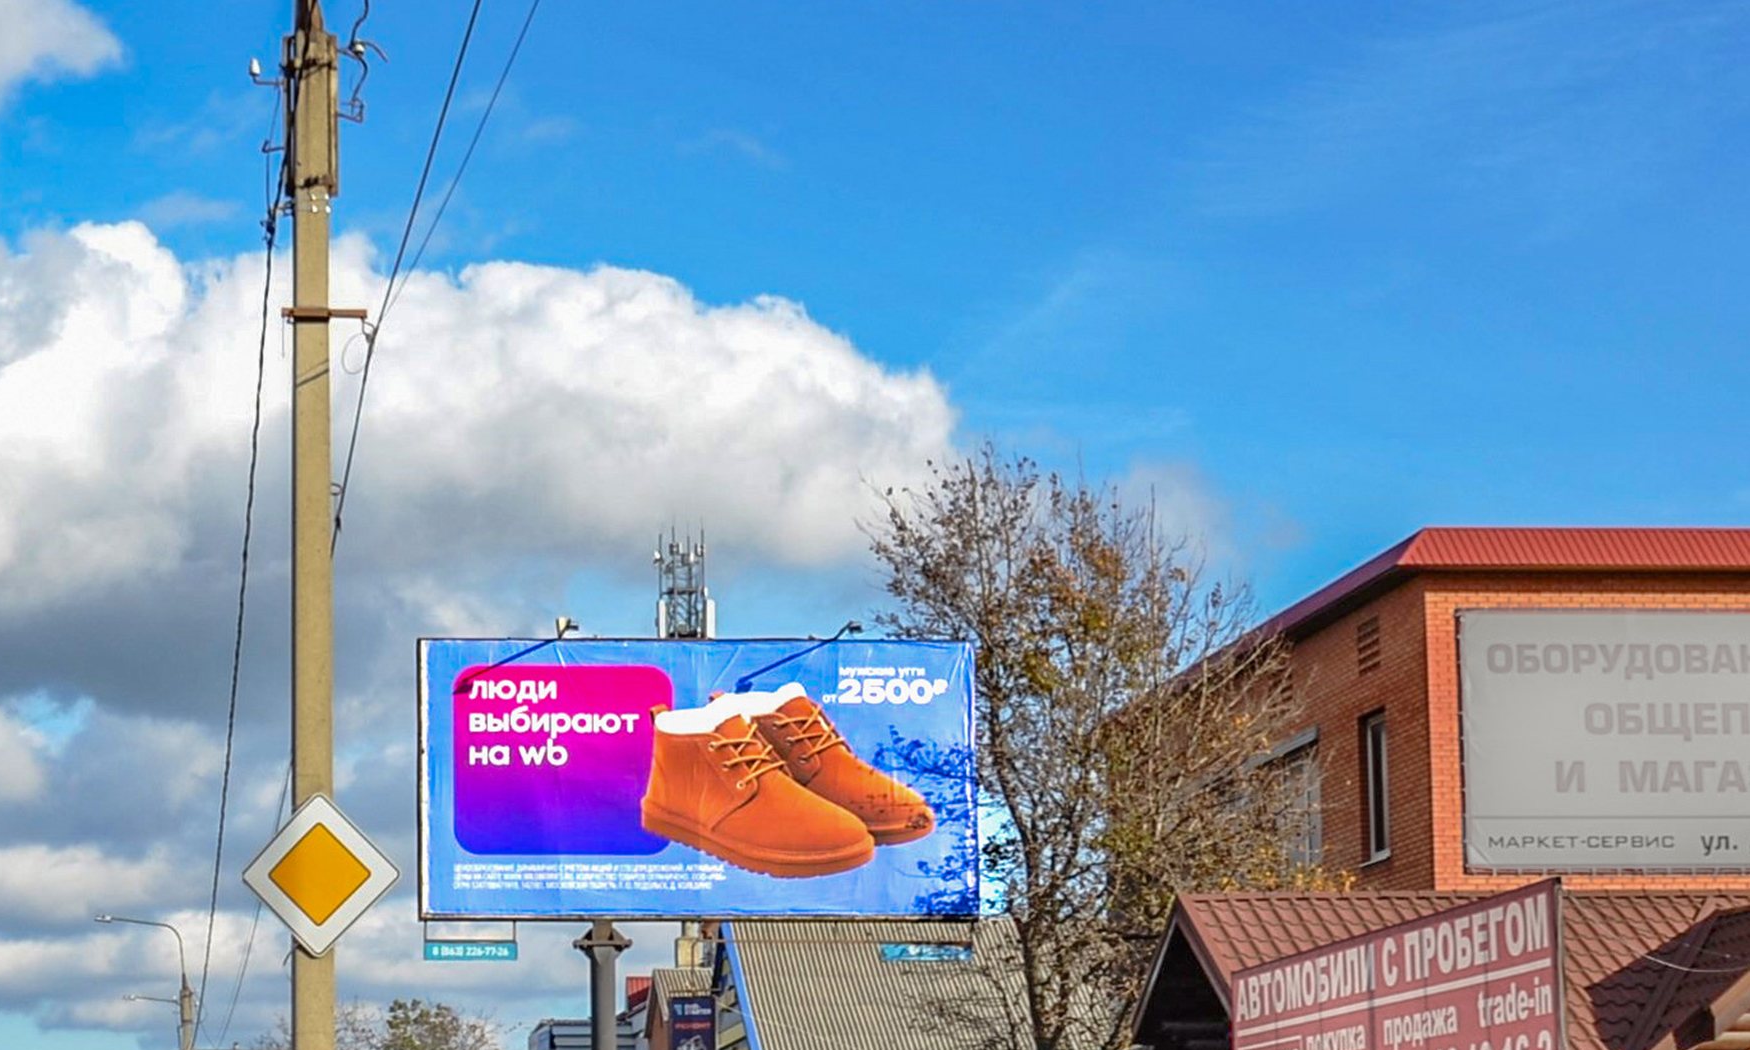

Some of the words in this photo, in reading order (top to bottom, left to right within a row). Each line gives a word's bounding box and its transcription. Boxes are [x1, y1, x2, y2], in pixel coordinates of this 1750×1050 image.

[468, 679, 558, 704] люди
[468, 705, 640, 740] выбирают
[1583, 702, 1750, 741] ОБЩЕП
[468, 745, 511, 766] на
[518, 738, 569, 766] wb
[1554, 760, 1586, 793] И
[1618, 760, 1748, 793] МАГА
[1487, 835, 1675, 849] МАРКЕТ-СЕРВИС
[1700, 835, 1739, 856] ул.
[1235, 942, 1376, 1024] АВТОМОБИЛИ
[1381, 937, 1399, 987] С
[1404, 893, 1549, 983] ПРОБЕГОМ
[1477, 976, 1552, 1028] trade-in
